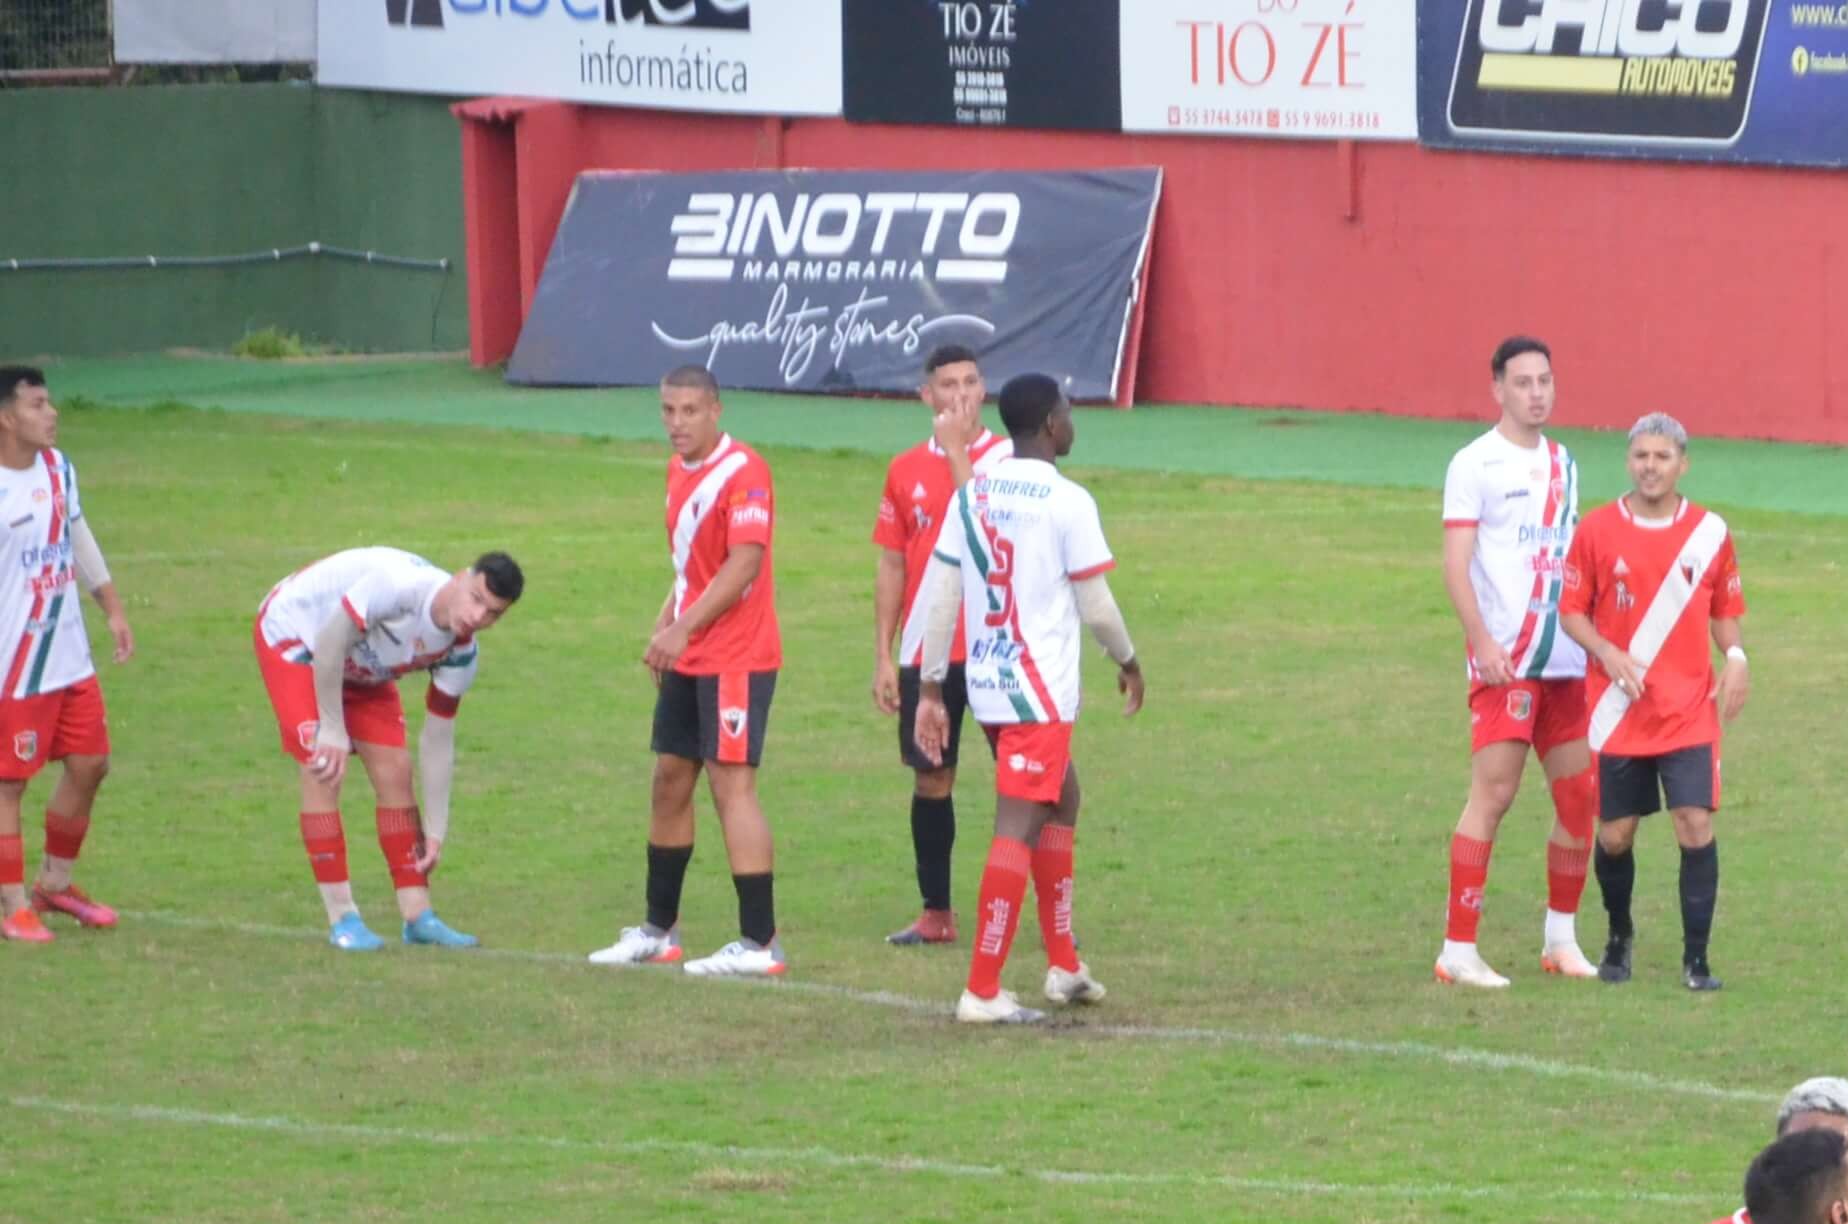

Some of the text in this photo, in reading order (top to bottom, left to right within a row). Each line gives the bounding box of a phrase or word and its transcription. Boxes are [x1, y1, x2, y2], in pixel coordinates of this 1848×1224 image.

[939, 0, 1017, 40] TIO ZÉ
[1176, 0, 1366, 88] TIO ZÉ
[580, 40, 748, 92] informática
[948, 40, 1011, 68] IMÓVEIS
[669, 192, 1020, 255] BINOTTO
[743, 261, 925, 280] MARMORARIA
[690, 283, 935, 384] quality stones
[985, 537, 1015, 628] 3
